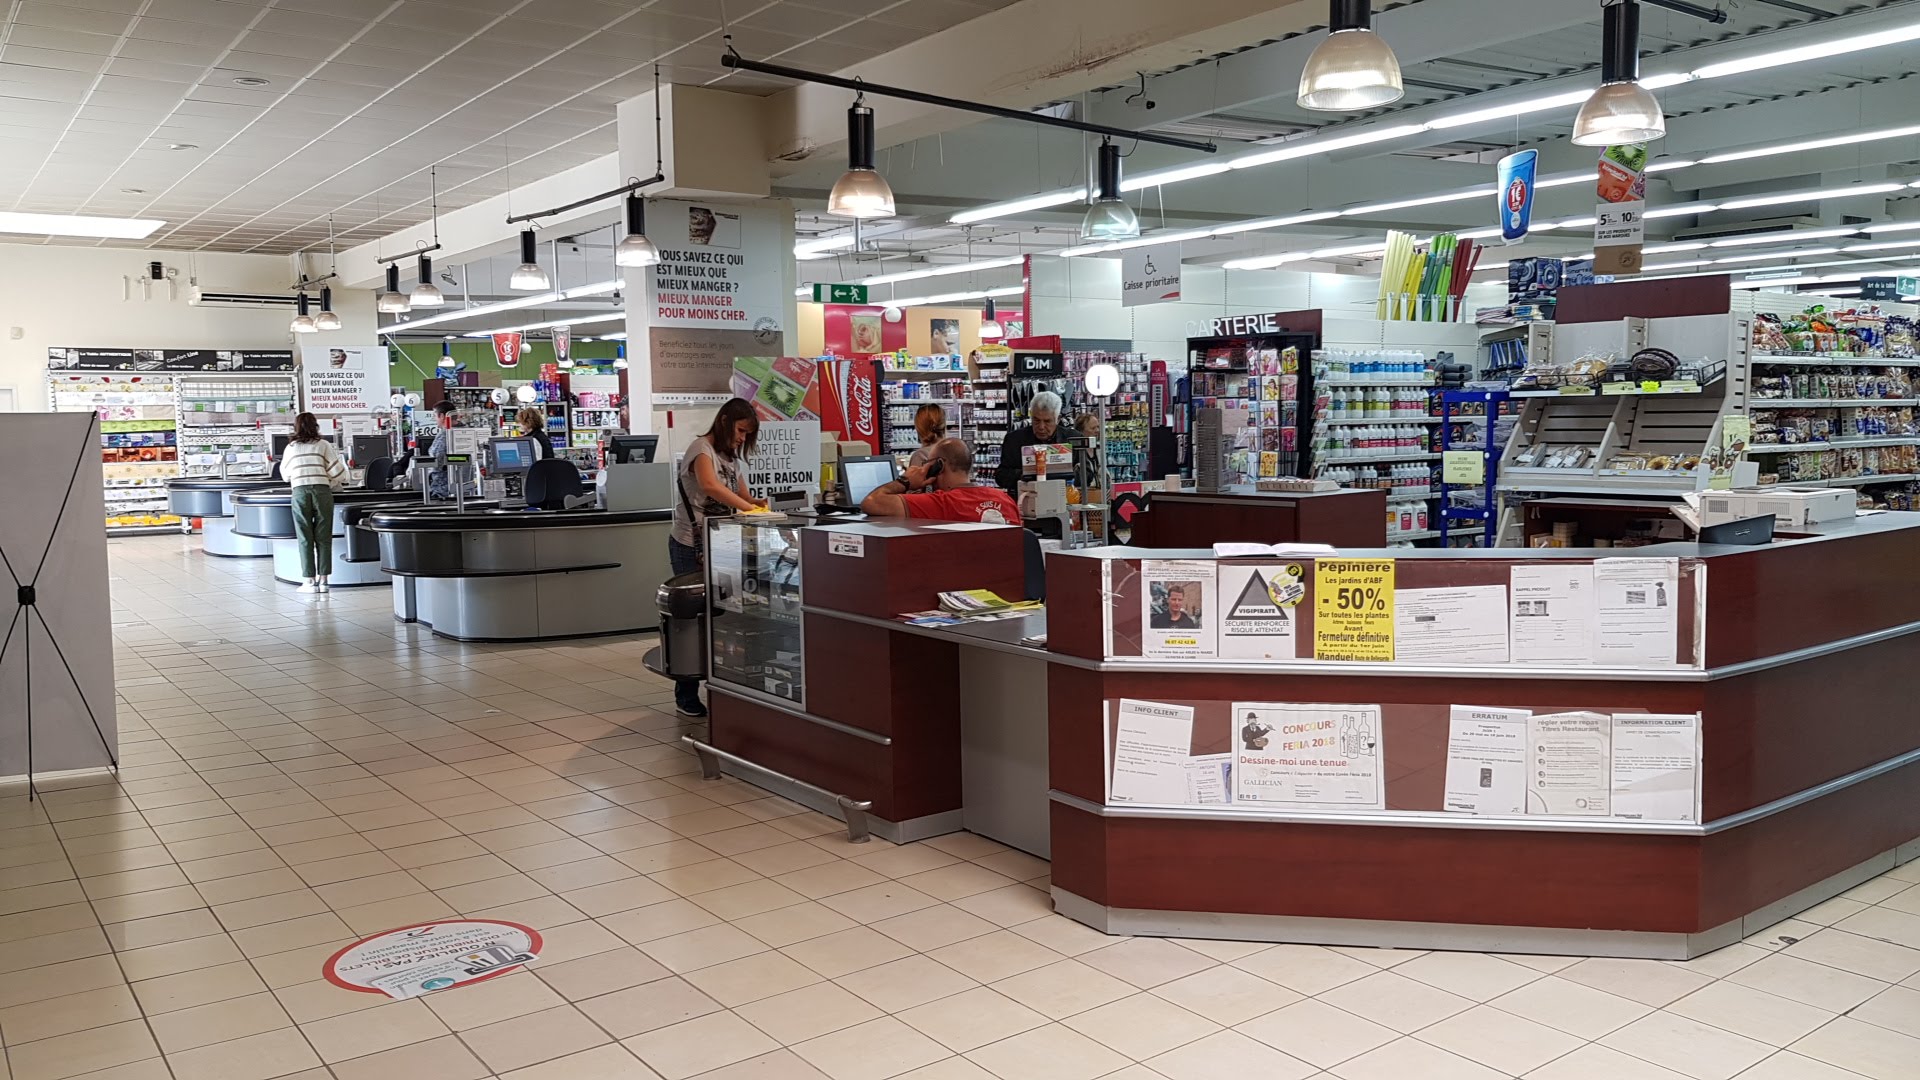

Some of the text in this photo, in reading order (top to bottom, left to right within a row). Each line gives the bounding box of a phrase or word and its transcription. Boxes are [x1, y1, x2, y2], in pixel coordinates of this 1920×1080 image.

[683, 251, 712, 264] SAVEZ
[714, 253, 724, 264] CE
[727, 254, 744, 266] QUI
[656, 264, 727, 278] EST MIEUX QUE
[657, 278, 739, 293] MIEUX MANGER ?
[1124, 275, 1179, 291] Caisse prioritaire
[658, 293, 732, 306] MIEUX MANGER
[659, 307, 748, 321] POUR MOINS CHER.
[1185, 314, 1277, 338] CARTERIE
[1026, 358, 1050, 370] DIM
[853, 374, 873, 436] Coca-Cola
[758, 428, 800, 441] OUVELLE
[783, 443, 796, 455] DE
[749, 456, 791, 470] FIDÉLITÉ
[748, 471, 813, 485] UNE RAISON
[749, 488, 763, 498] DE
[980, 501, 994, 509] SUIS
[994, 502, 1001, 511] LA
[1338, 577, 1361, 585] jardins
[1337, 588, 1385, 610] 50%
[1365, 612, 1389, 620] plantes
[1318, 631, 1390, 642] Fermeture définitive
[1317, 652, 1353, 661] Manduel
[1283, 720, 1336, 734] CONCOURS
[1283, 736, 1335, 751] FERIA 2018
[1240, 756, 1297, 765] Dessine-moi
[413, 934, 500, 956] DISTRIBUTEUR
[339, 957, 391, 972] BILLETS
[383, 958, 412, 969] PAS
